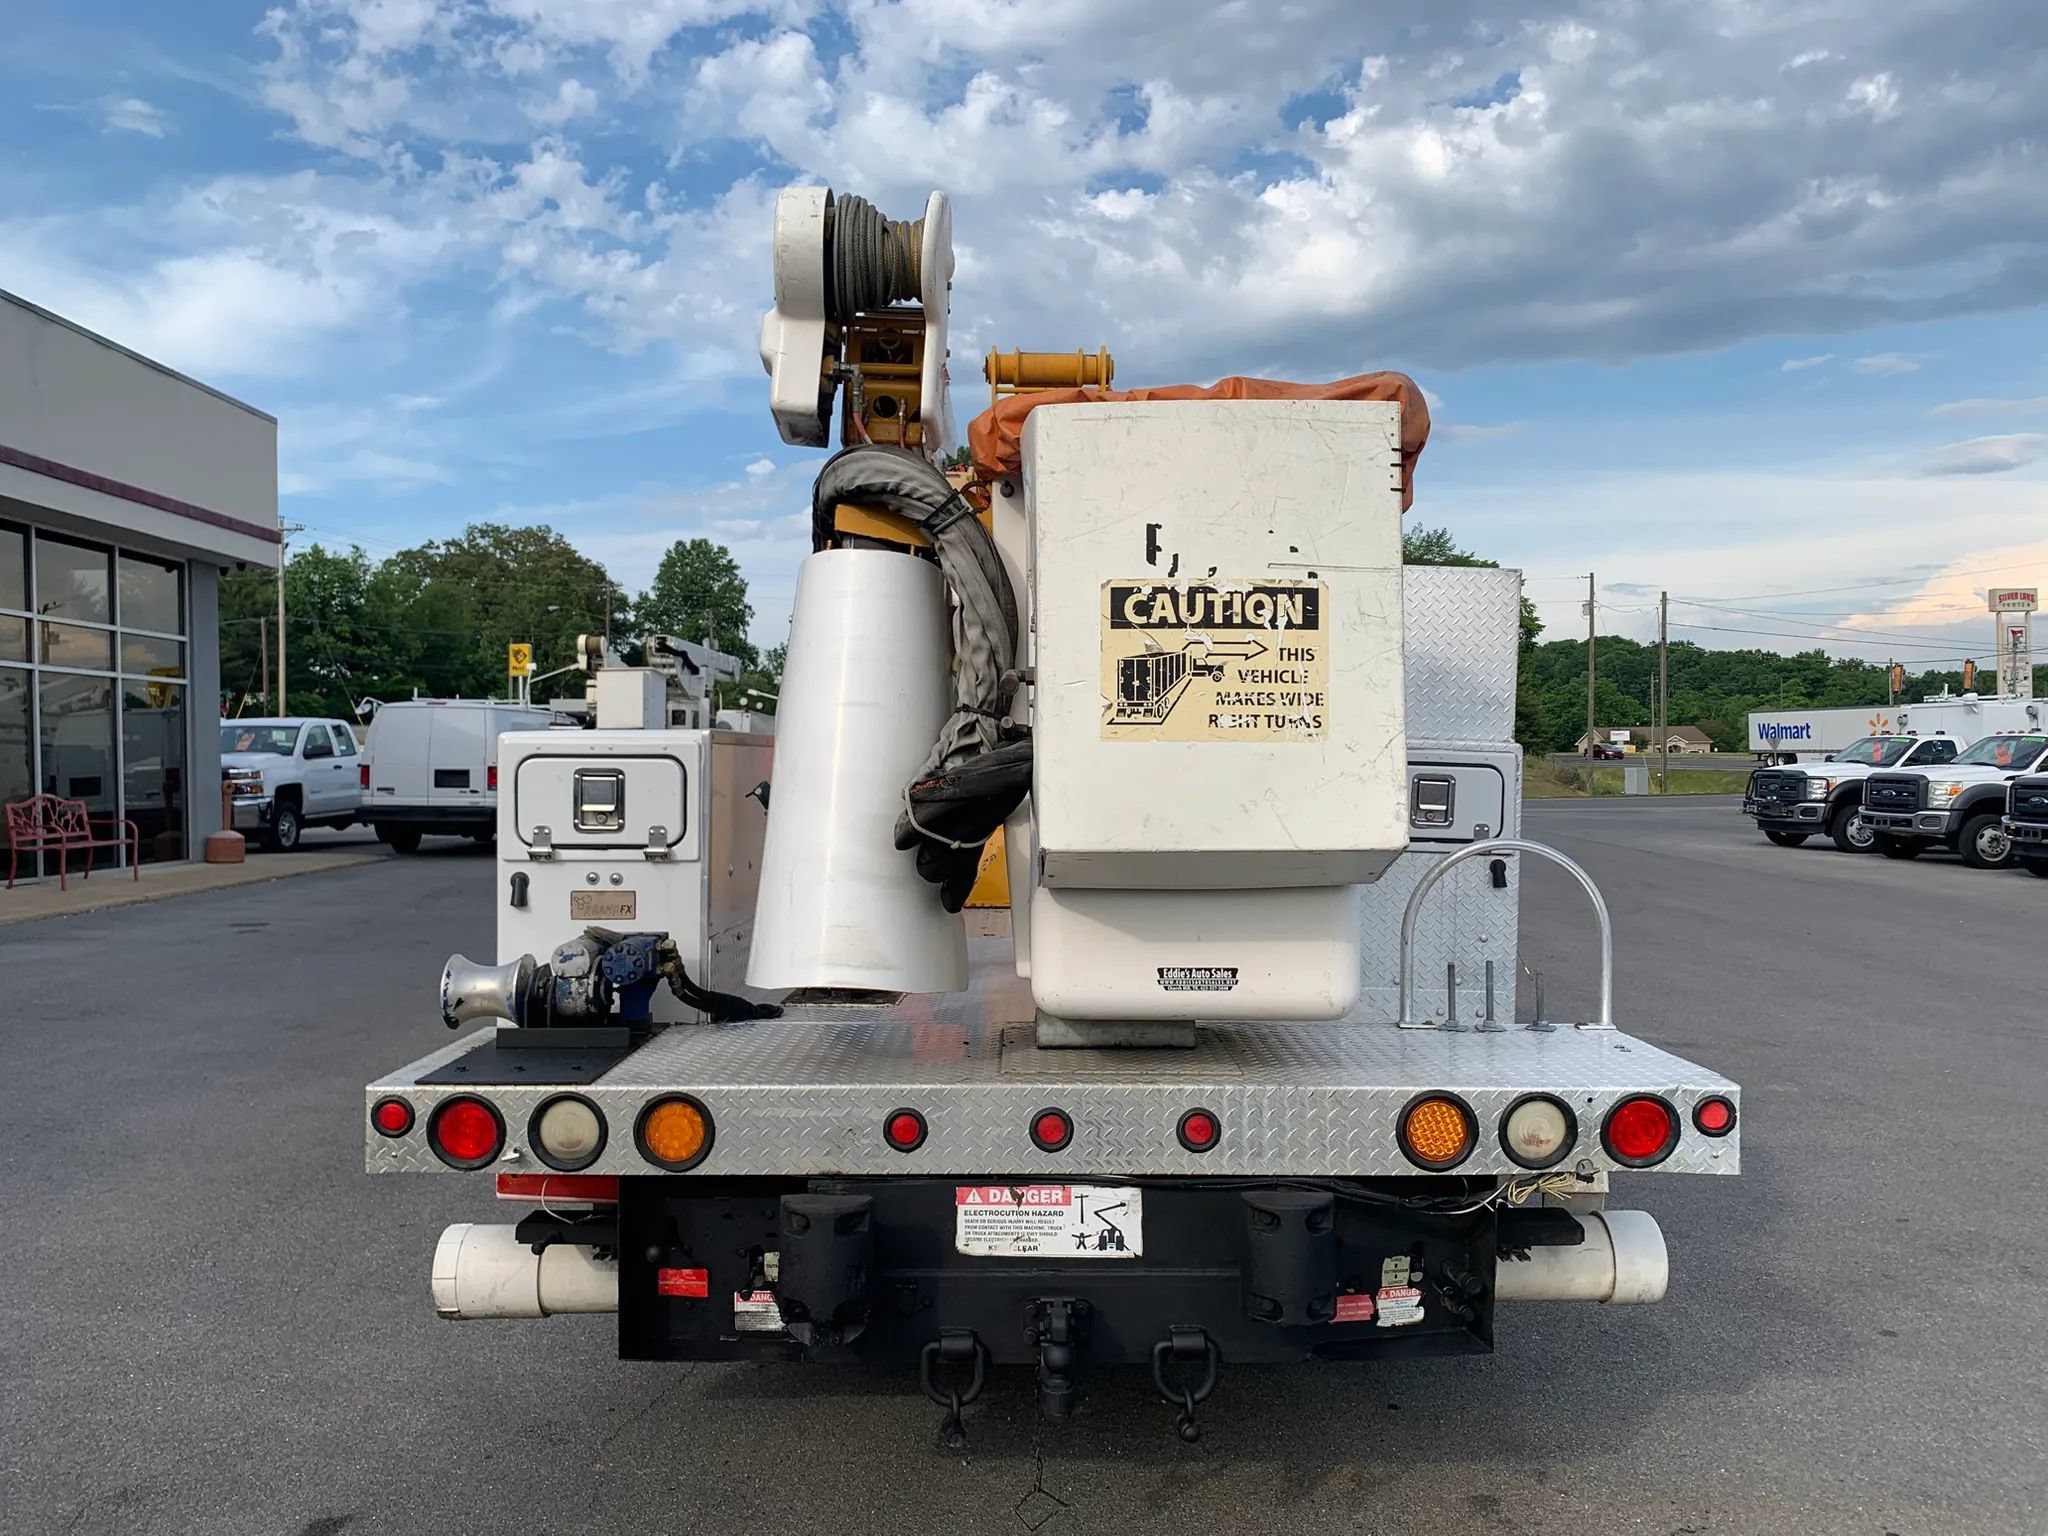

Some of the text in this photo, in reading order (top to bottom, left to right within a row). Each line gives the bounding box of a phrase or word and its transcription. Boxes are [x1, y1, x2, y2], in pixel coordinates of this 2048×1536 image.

[1998, 592, 2018, 603] SILVER
[1123, 592, 1304, 625] CAUTION
[1279, 647, 1316, 662] THIS
[1237, 669, 1309, 684] VEHICLE
[1215, 691, 1325, 706] MAKES WIDE
[1208, 713, 1261, 728] RGHT
[1757, 722, 1812, 740] Walmart
[1163, 968, 1232, 978] Eddie's Auto Sales
[963, 1209, 1065, 1217] ELECTROCUTION HAZARD
[1012, 1244, 1039, 1252] LEAR
